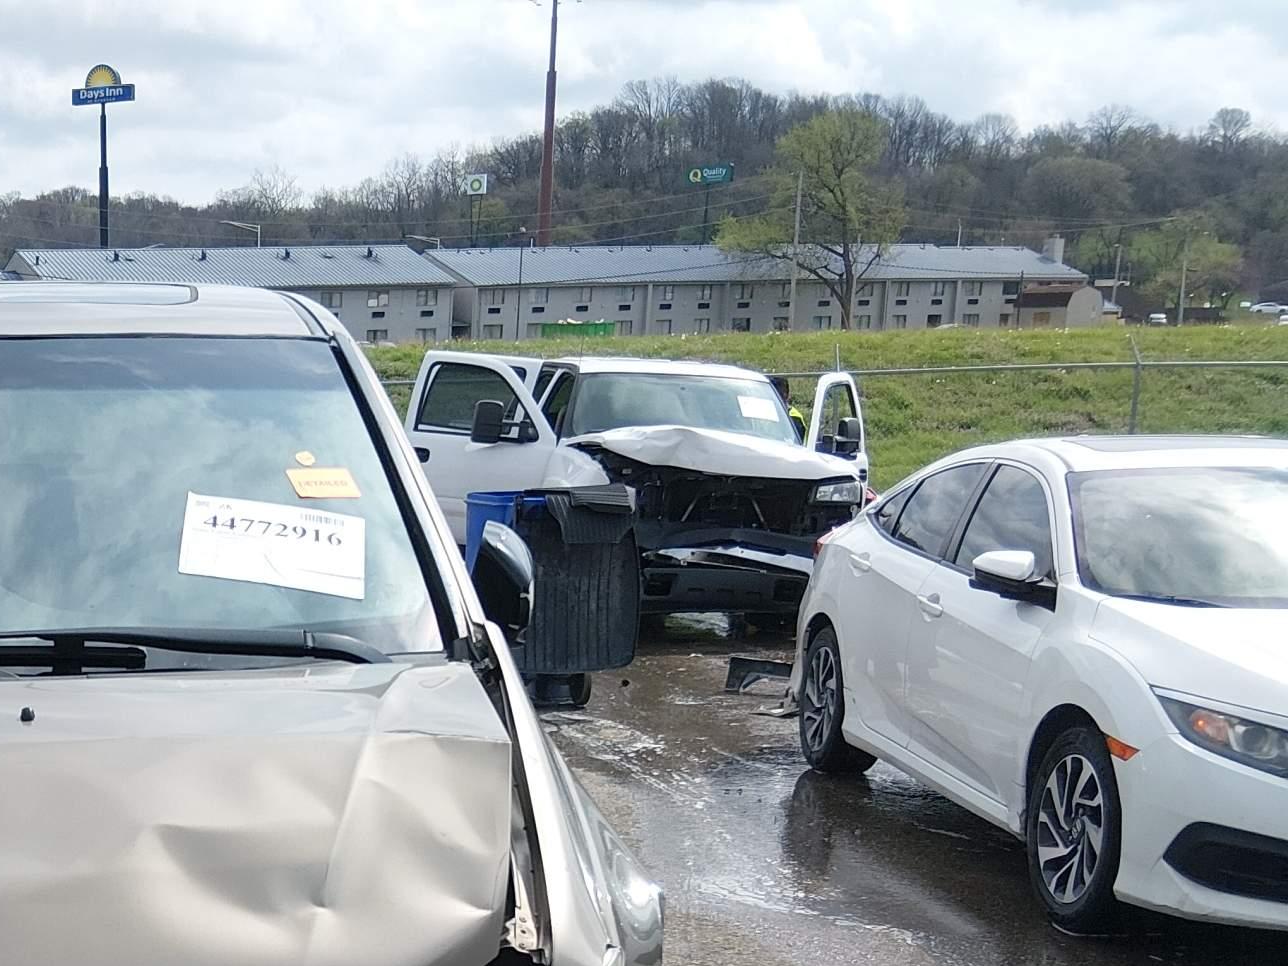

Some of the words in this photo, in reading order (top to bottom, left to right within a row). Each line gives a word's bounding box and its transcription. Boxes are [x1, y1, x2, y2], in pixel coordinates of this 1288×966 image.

[79, 88, 105, 100] Days
[105, 87, 123, 97] Inn
[702, 167, 727, 177] Quality
[203, 514, 342, 546] 44772916
